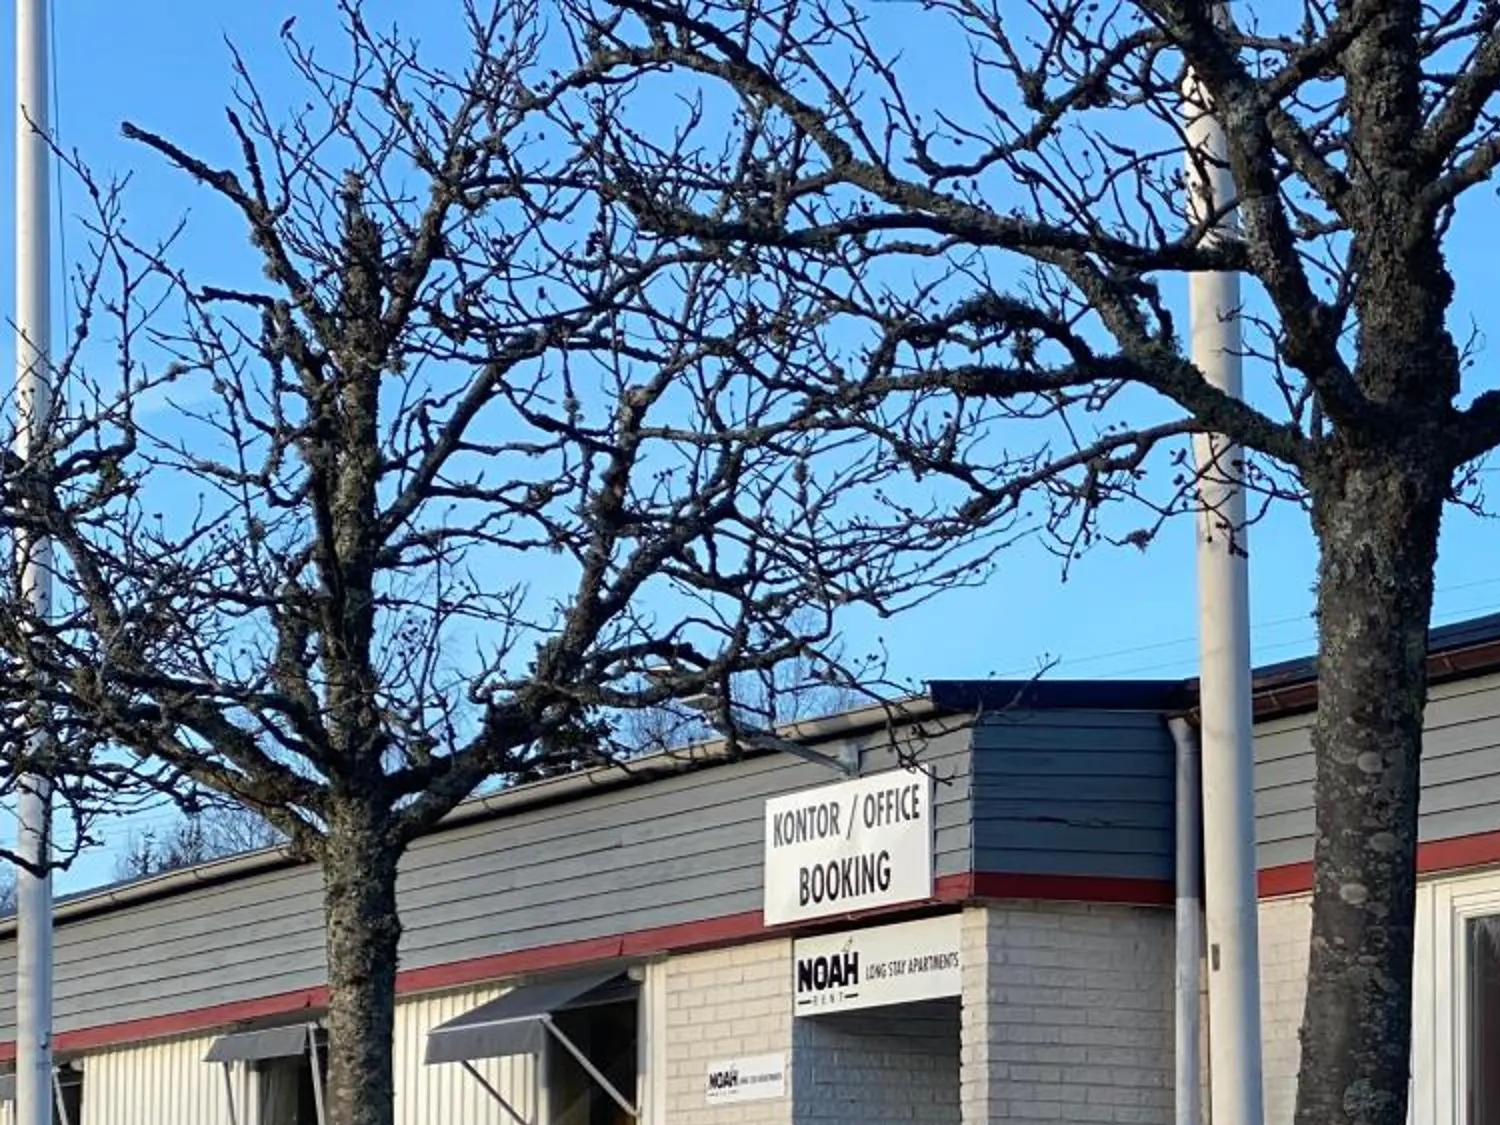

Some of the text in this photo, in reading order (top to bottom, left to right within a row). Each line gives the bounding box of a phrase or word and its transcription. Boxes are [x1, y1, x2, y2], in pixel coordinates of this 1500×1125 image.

[773, 801, 841, 848] KONTOR
[863, 784, 920, 829] OFFICE
[799, 850, 891, 907] BOOKING
[797, 951, 859, 993] NOAH
[865, 951, 959, 981] LONG STAY APARTMENTS
[709, 1070, 738, 1089] NOAH
